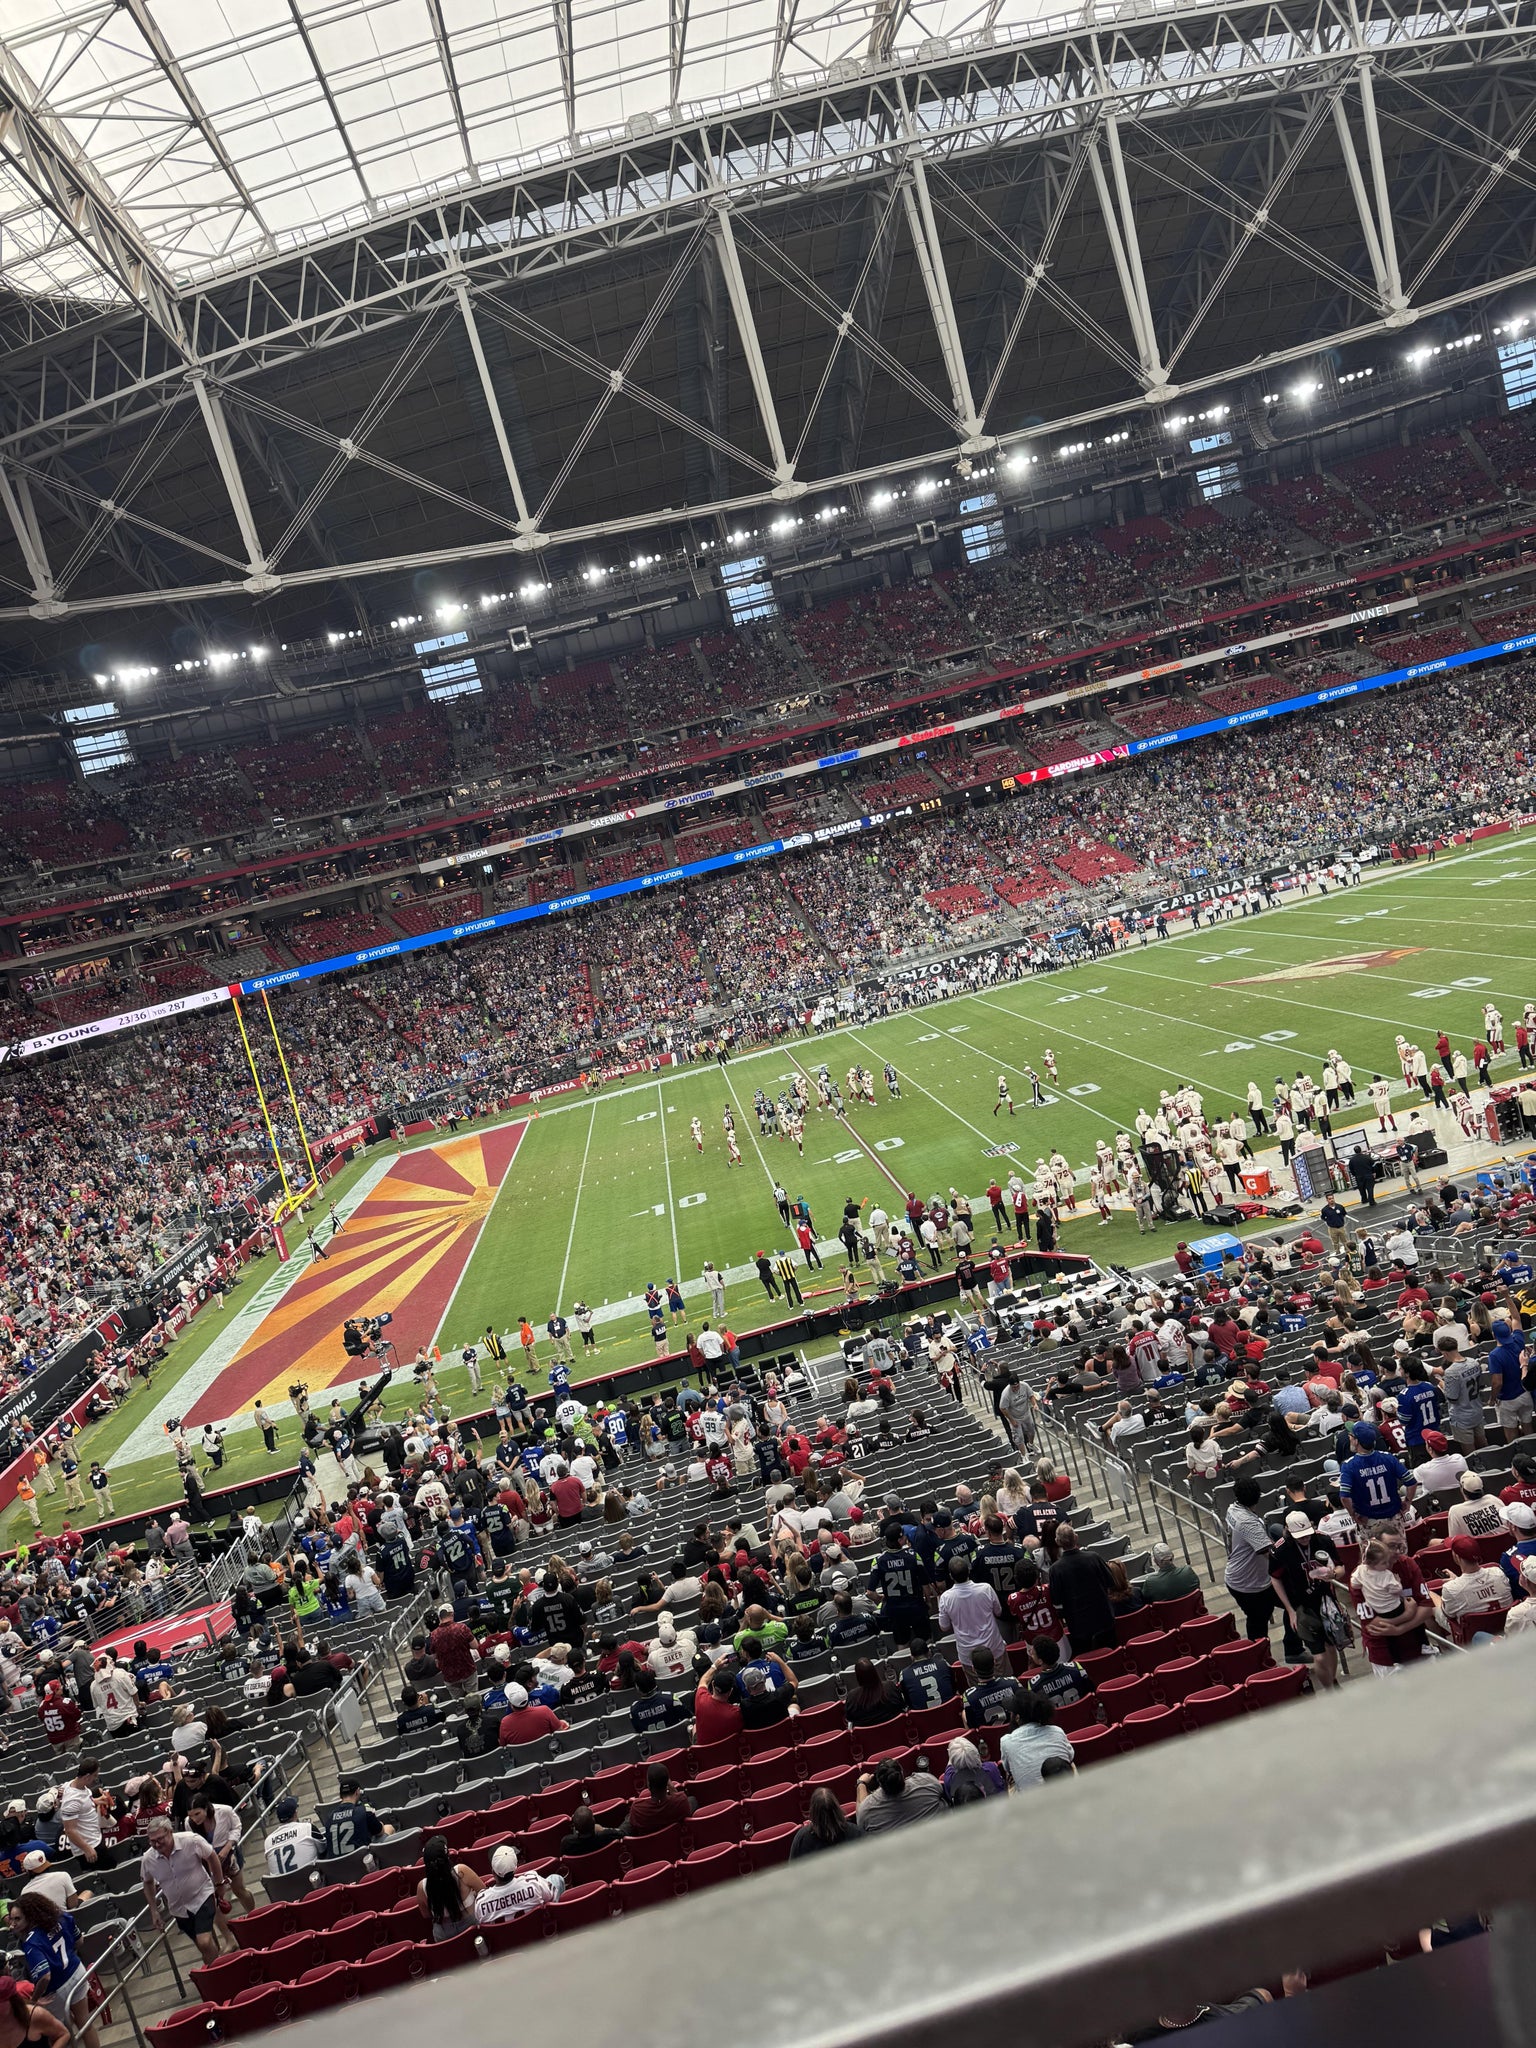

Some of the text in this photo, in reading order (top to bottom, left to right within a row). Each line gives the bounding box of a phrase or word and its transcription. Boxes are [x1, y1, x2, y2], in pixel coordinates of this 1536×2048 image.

[1305, 577, 1357, 596] CHARLEY TRIPPI
[1350, 604, 1390, 623] AVNET
[1155, 618, 1204, 636] ROGER WEHRLI
[1418, 661, 1447, 674] HYUNDAI
[1329, 685, 1358, 698] HYUNDAI
[847, 712, 860, 721] PAT
[860, 704, 889, 717] TILLMAN
[1239, 709, 1269, 722] HYUNDAI
[1148, 734, 1178, 747] HYUNDAI
[618, 769, 649, 782] WILLIAM
[658, 760, 687, 772] BIDWILL
[1030, 754, 1097, 781] 7 CARDINALS
[744, 772, 782, 787] Spectrum
[493, 801, 526, 814] CHARLES
[567, 787, 579, 797] SR.
[678, 790, 715, 805] HYUNDAI
[905, 806, 913, 815] 4
[920, 798, 942, 812] 1:11
[590, 813, 625, 828] SAFEWAY
[814, 814, 885, 839] SEAHAWKS 30
[525, 833, 553, 845] FINANCIAL
[456, 849, 489, 863] BETMGM
[745, 845, 775, 858] HYUNDAI
[653, 869, 683, 883] HYUNDAI
[103, 885, 171, 904] AENEAS WILLIAMS
[560, 894, 591, 909] HYUNDAI
[1159, 875, 1262, 913] CARDINAS
[465, 919, 496, 932] HYUNDAI
[368, 945, 400, 959] HYUNDAI
[265, 971, 300, 986] HYUNDAI
[211, 992, 218, 1000] 3
[168, 1001, 186, 1012] 287
[118, 1012, 147, 1026] 23/36
[32, 1025, 100, 1049] B.YOUNG
[1223, 1030, 1299, 1053] 40
[137, 1153, 150, 1165] 12
[1246, 1178, 1257, 1190] G
[162, 1242, 209, 1286] ARIZONA CARDINALS
[1483, 1279, 1503, 1291] FITZGERALD
[1172, 1331, 1184, 1347] 85
[1143, 1345, 1155, 1361] 11
[562, 1405, 575, 1417] 99
[1420, 1401, 1436, 1425] 11
[609, 1418, 623, 1435] 80
[706, 1422, 716, 1433] 99
[764, 1451, 776, 1465] 3
[852, 1443, 866, 1458] 21
[437, 1455, 449, 1465] 18
[529, 1458, 540, 1467] 11
[549, 1466, 556, 1477] 4
[1359, 1465, 1388, 1478] SMITH-NJIGBA
[466, 1480, 476, 1490] 11
[1365, 1476, 1391, 1506] 11
[424, 1494, 442, 1505] 85
[1520, 1488, 1536, 1498] PETE
[359, 1511, 368, 1524] 3
[1033, 1508, 1057, 1517] URLACHER
[1462, 1504, 1497, 1523] DISCIPLE OF
[243, 1520, 250, 1531] 5
[486, 1516, 503, 1533] 25
[1467, 1514, 1504, 1537] CHRIST
[446, 1544, 465, 1562] 22
[951, 1543, 969, 1556] LYNCH
[392, 1553, 408, 1570] 14
[420, 1556, 430, 1569] 6
[887, 1558, 905, 1568] LYNCH
[885, 1569, 914, 1597] 24
[990, 1566, 1017, 1592] 12
[493, 1588, 511, 1597] PARSONS
[1476, 1585, 1497, 1600] LOVE
[501, 1600, 510, 1614] 1
[1357, 1602, 1375, 1619] 40
[546, 1617, 567, 1632] 15
[840, 1623, 868, 1639] THOMPSON
[664, 1651, 684, 1663] BAKER
[913, 1663, 938, 1677] WILSON
[571, 1681, 595, 1696] MATHIEU
[920, 1676, 942, 1710] 3
[1043, 1676, 1073, 1695] BALDWIN
[106, 1693, 118, 1709] 4
[979, 1687, 1015, 1708] WITHERSPOON
[45, 1716, 65, 1732] 85
[333, 1809, 353, 1820] WISEMAN
[271, 1829, 298, 1845] WISEMAN
[330, 1820, 355, 1856] 12
[273, 1844, 299, 1875] 12
[481, 1887, 535, 1916] FITZGERALD
[53, 1936, 69, 1970] 7
